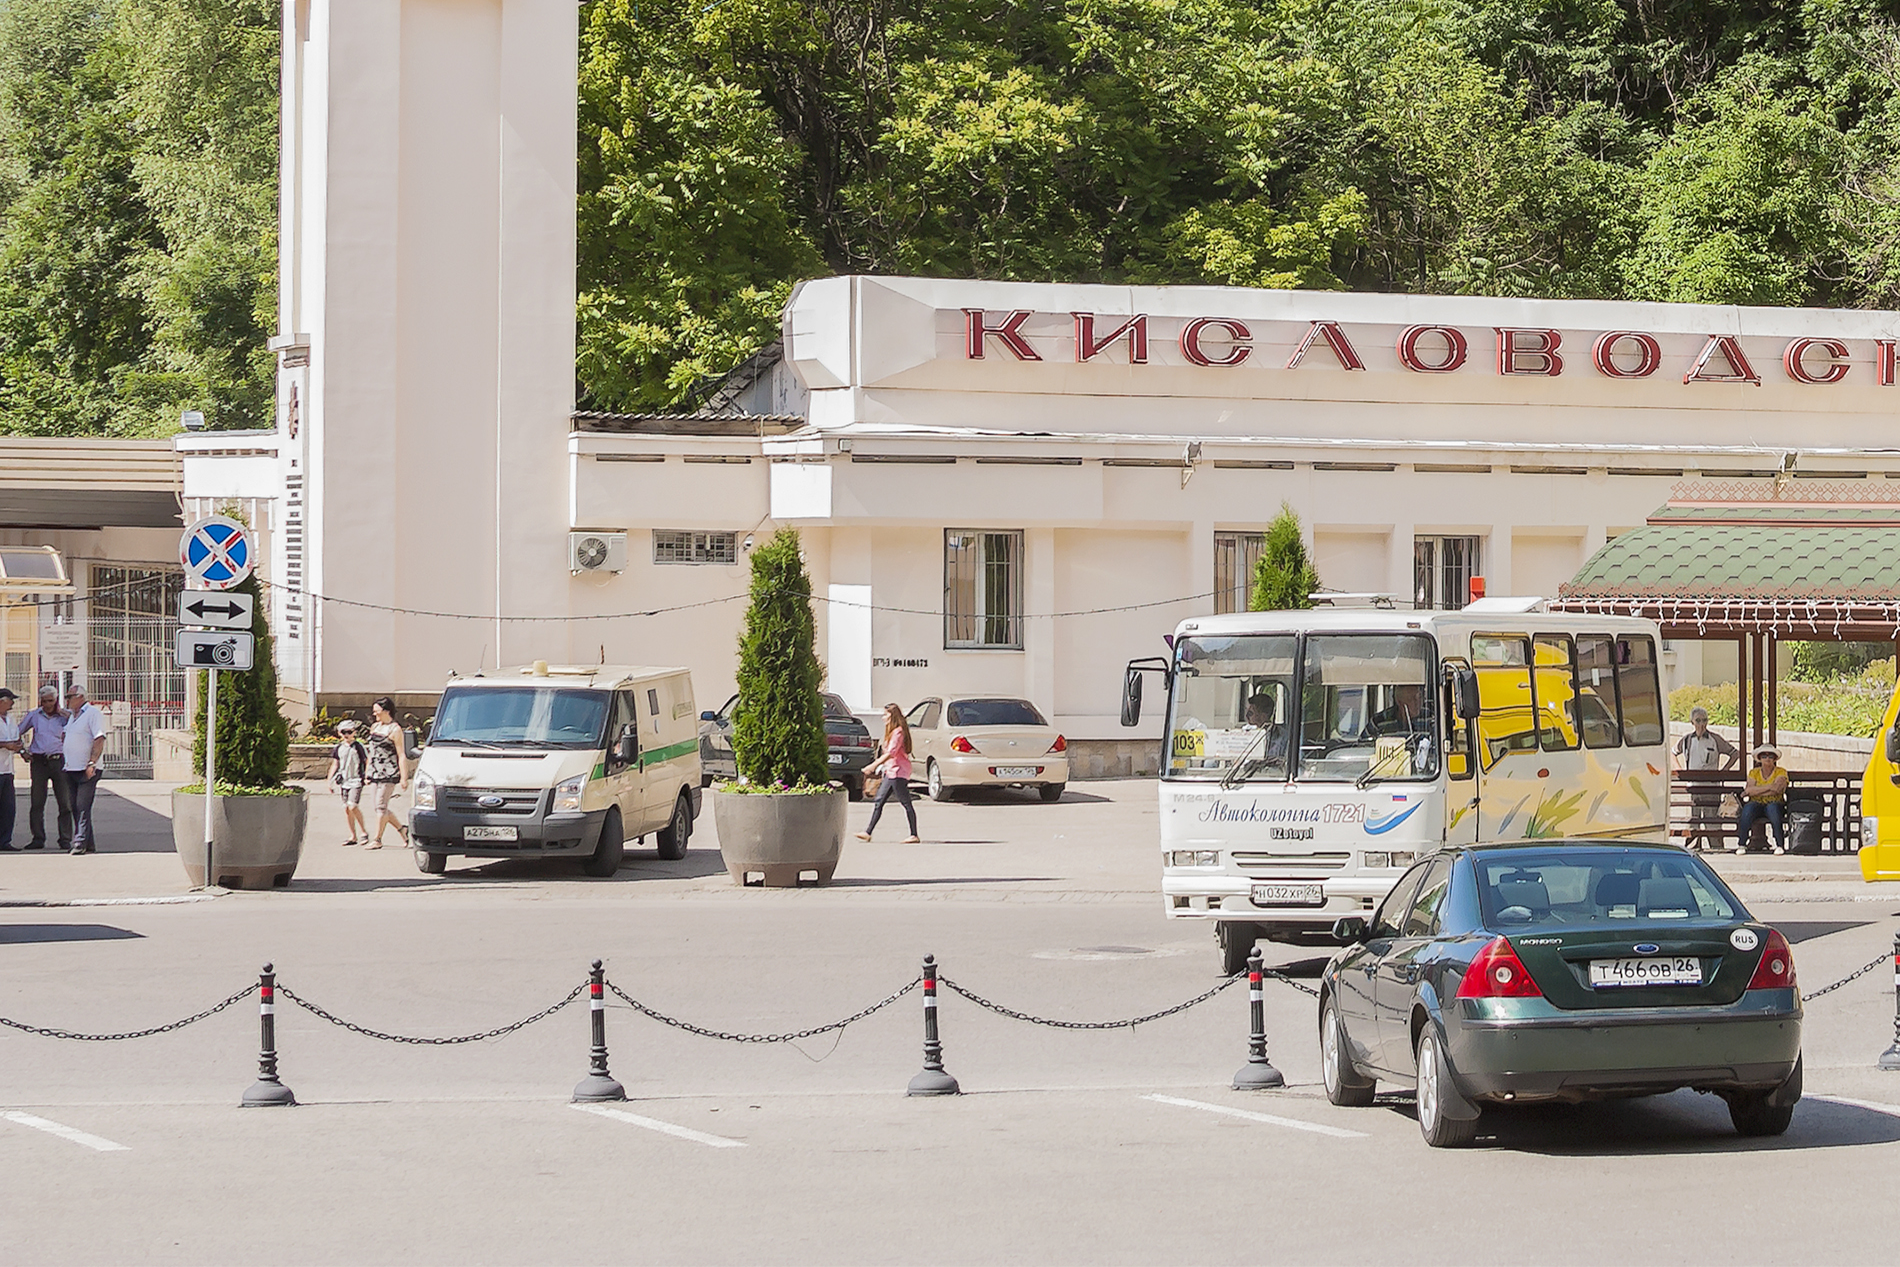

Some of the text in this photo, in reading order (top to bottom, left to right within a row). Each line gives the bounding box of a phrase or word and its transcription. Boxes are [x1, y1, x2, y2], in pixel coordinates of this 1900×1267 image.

[1173, 734, 1196, 751] 103
[1199, 799, 1321, 823] Автоколонна
[1322, 804, 1366, 824] 1721
[1257, 887, 1304, 900] Н032ХР
[1734, 934, 1755, 945] RUS
[1599, 958, 1695, 980] Т466ОВ 26
